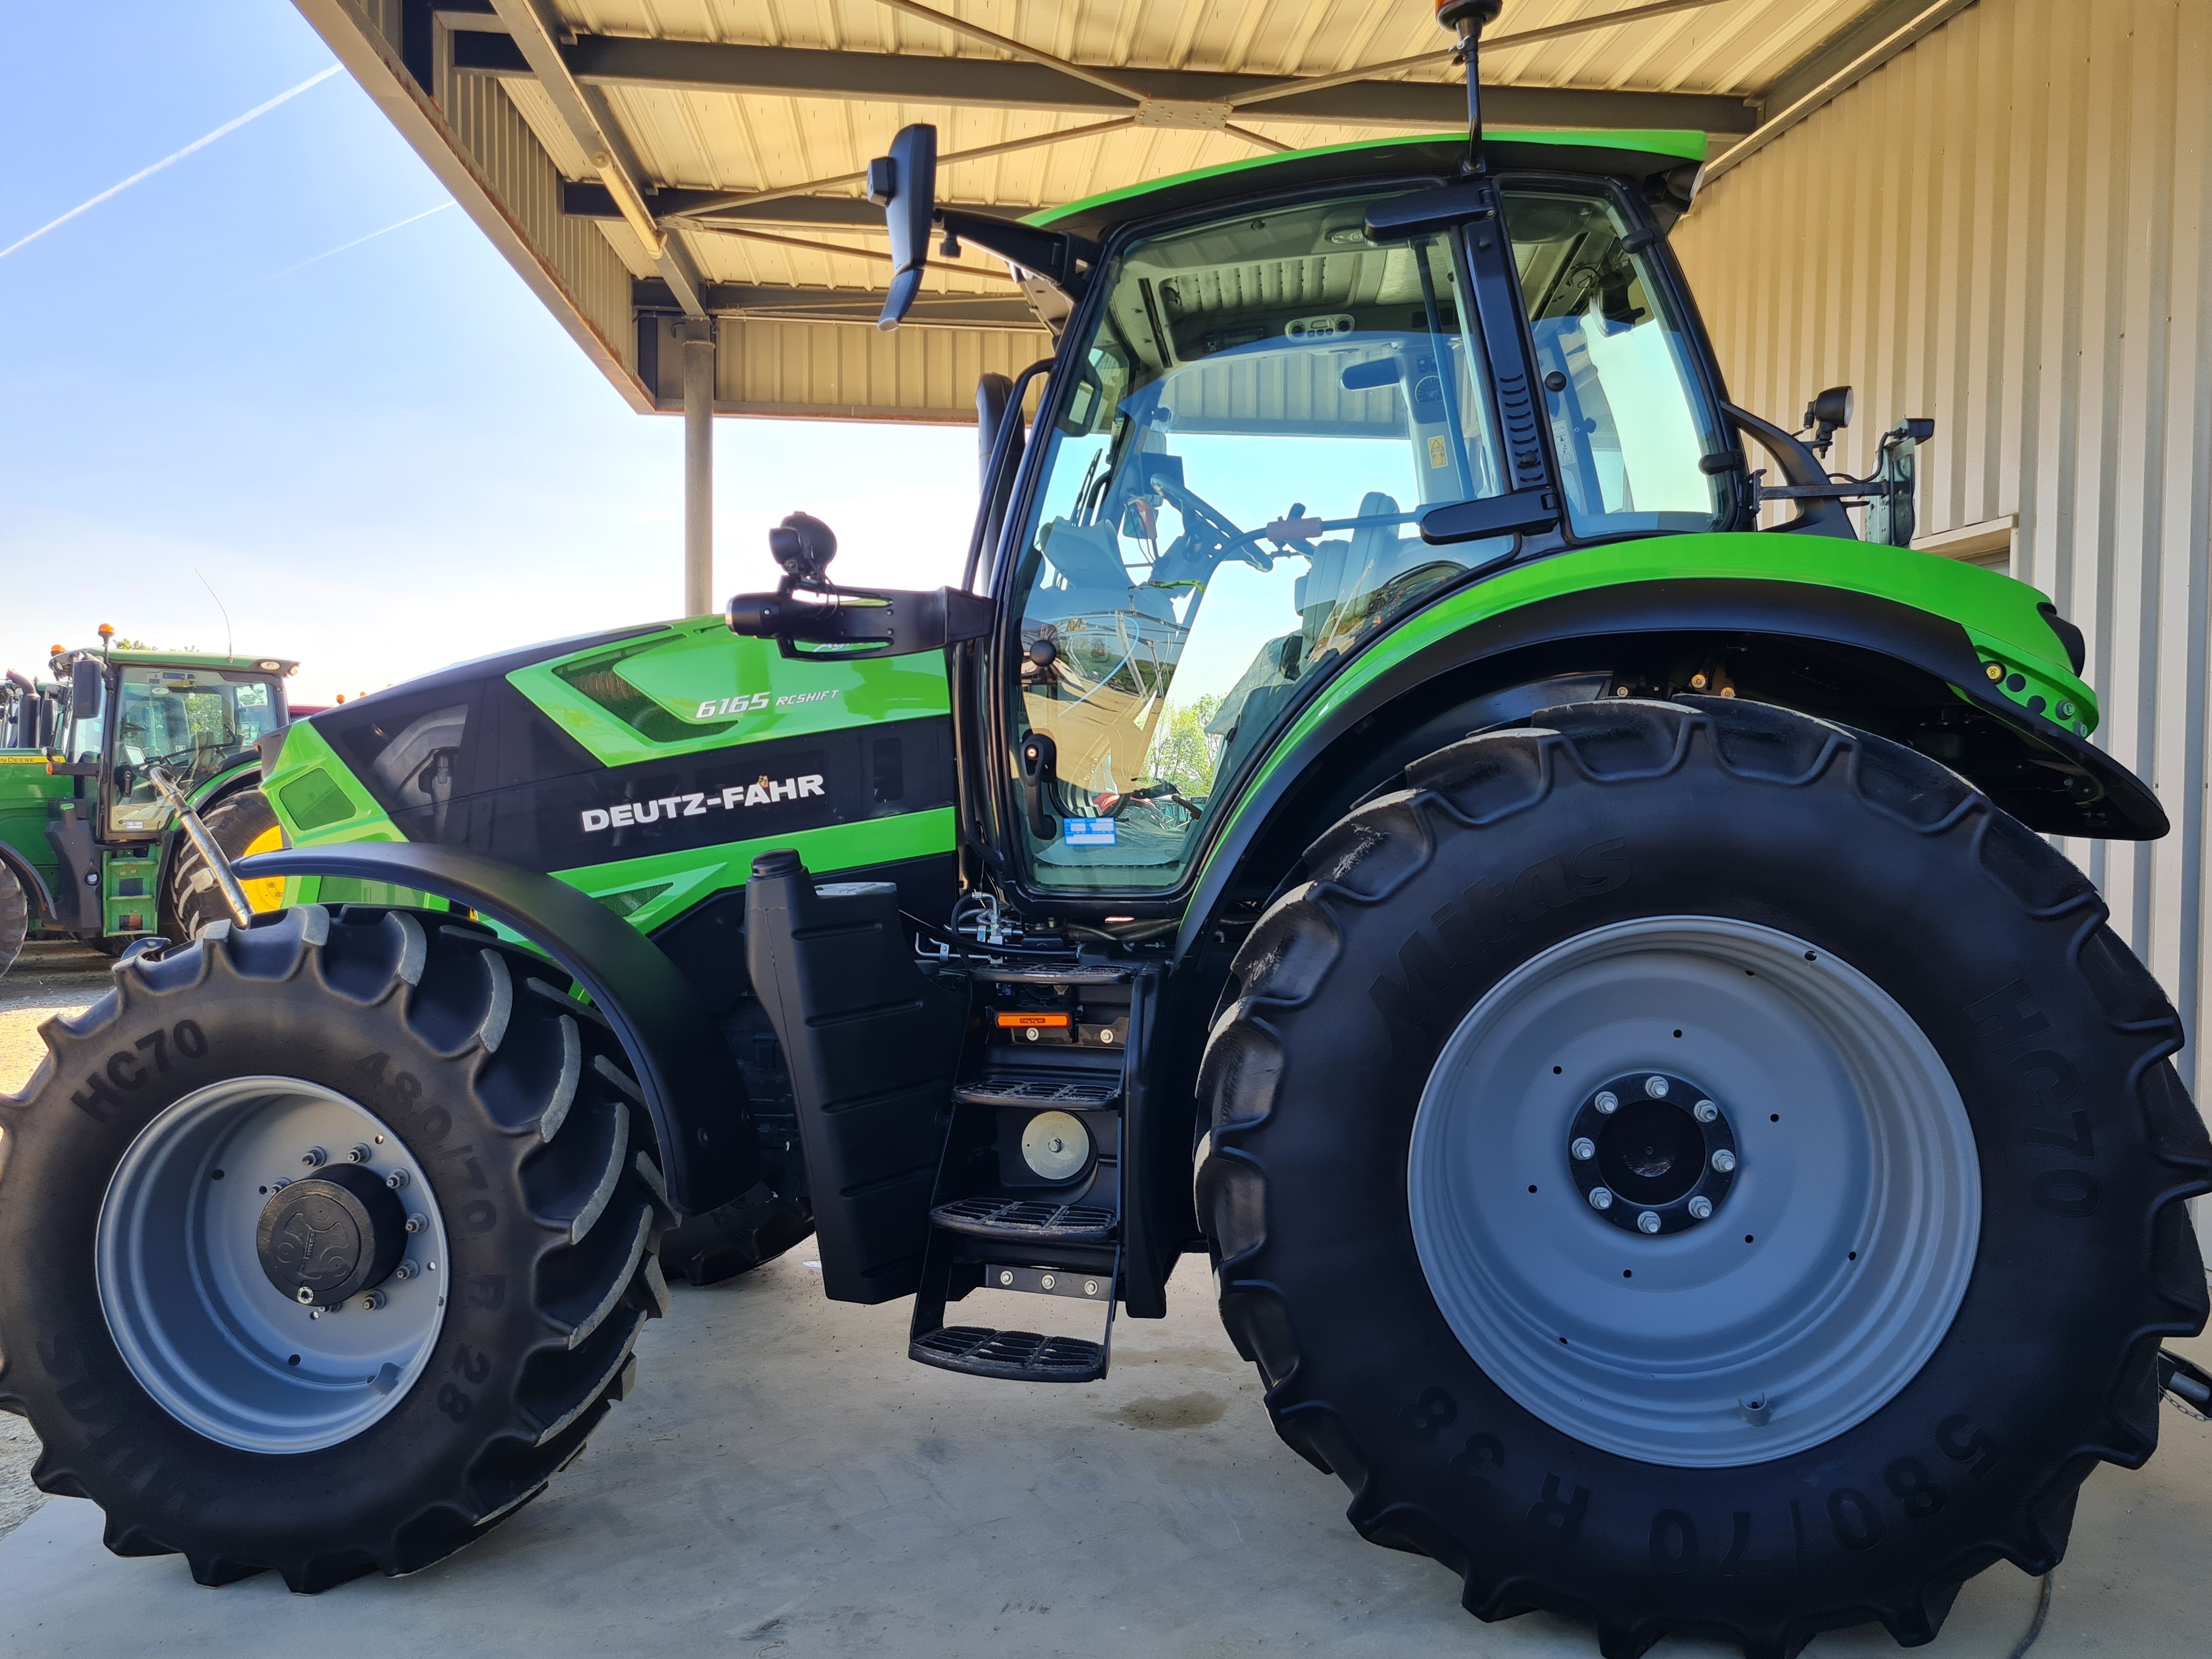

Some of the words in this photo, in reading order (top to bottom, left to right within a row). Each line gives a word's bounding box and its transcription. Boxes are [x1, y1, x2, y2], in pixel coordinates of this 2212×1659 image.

[696, 691, 771, 719] 6165
[775, 690, 839, 707] RCSHIFT
[582, 774, 826, 832] DEUTZ-FAHR
[70, 1018, 209, 1123] HC70
[1962, 977, 2103, 1218] HC70
[353, 1051, 497, 1235] 480/70
[468, 1273, 505, 1312] R
[436, 1344, 491, 1424] 28
[1398, 1385, 1505, 1489] 38
[1526, 1470, 1592, 1549] R
[1647, 1413, 2006, 1578] 580/70
